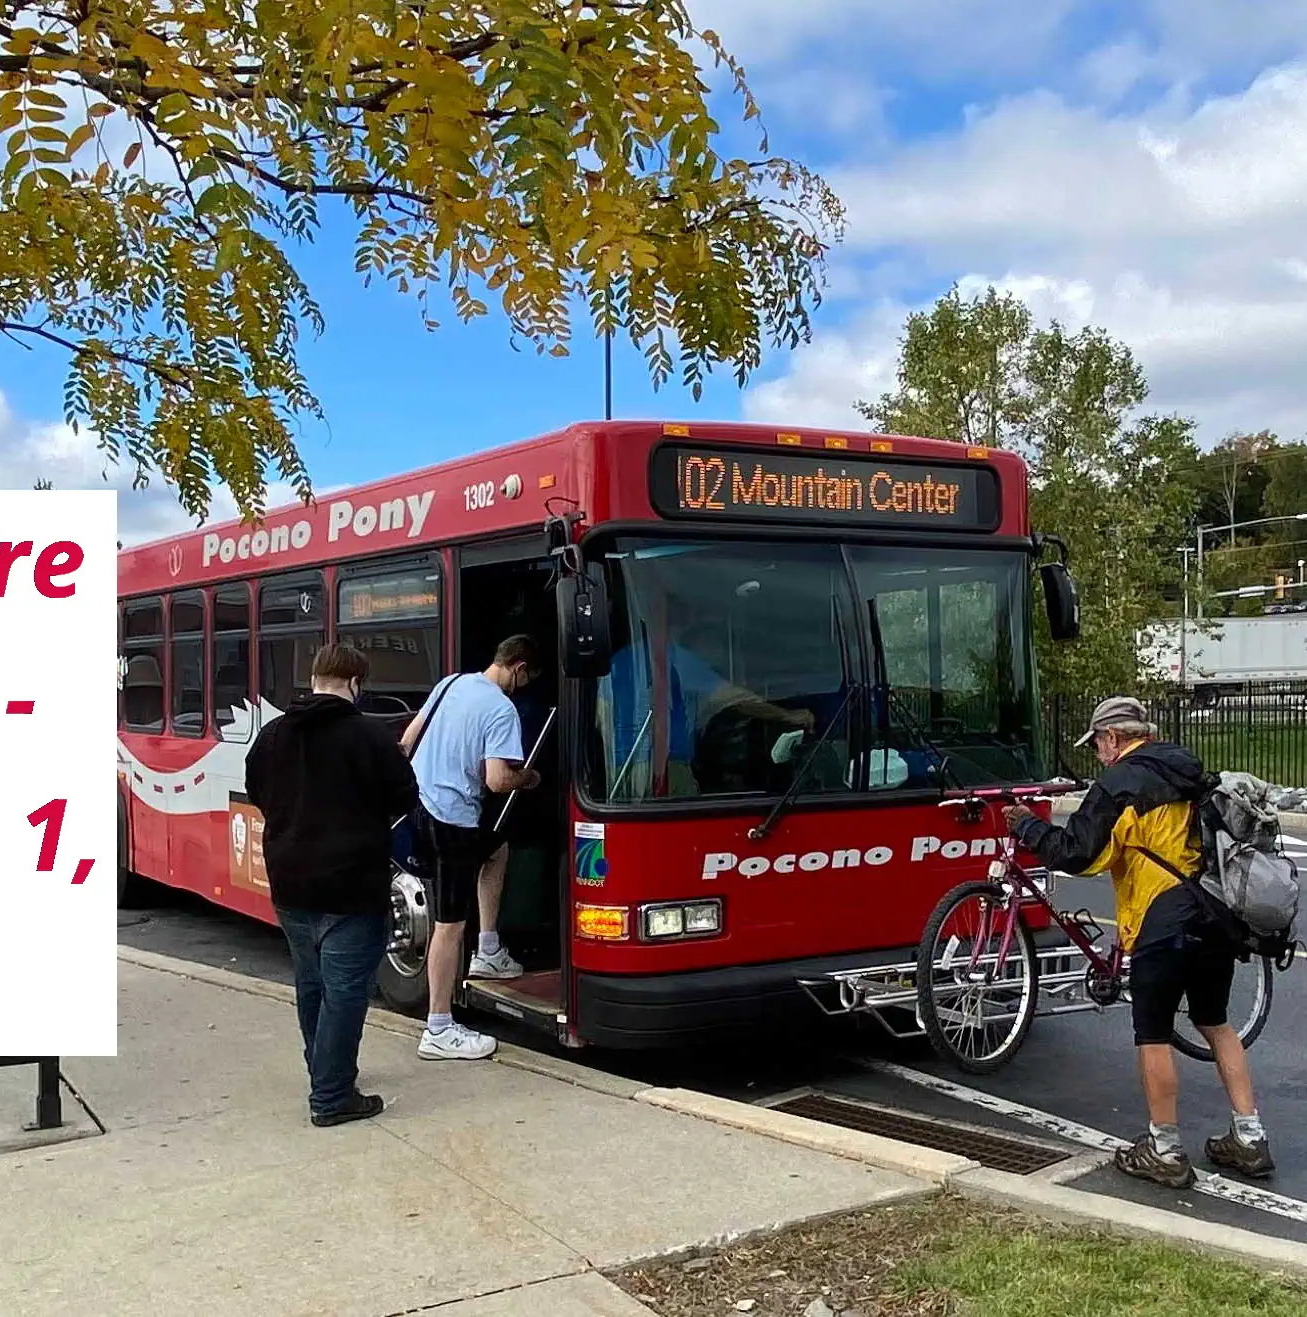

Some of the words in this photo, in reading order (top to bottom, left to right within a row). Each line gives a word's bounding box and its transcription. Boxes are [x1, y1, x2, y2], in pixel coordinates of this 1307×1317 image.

[463, 480, 495, 512] 1302
[732, 462, 863, 511] Mountain
[869, 470, 960, 515] Center
[202, 520, 312, 568] Pocono
[327, 490, 437, 543] Pony
[701, 845, 894, 881] Pocono
